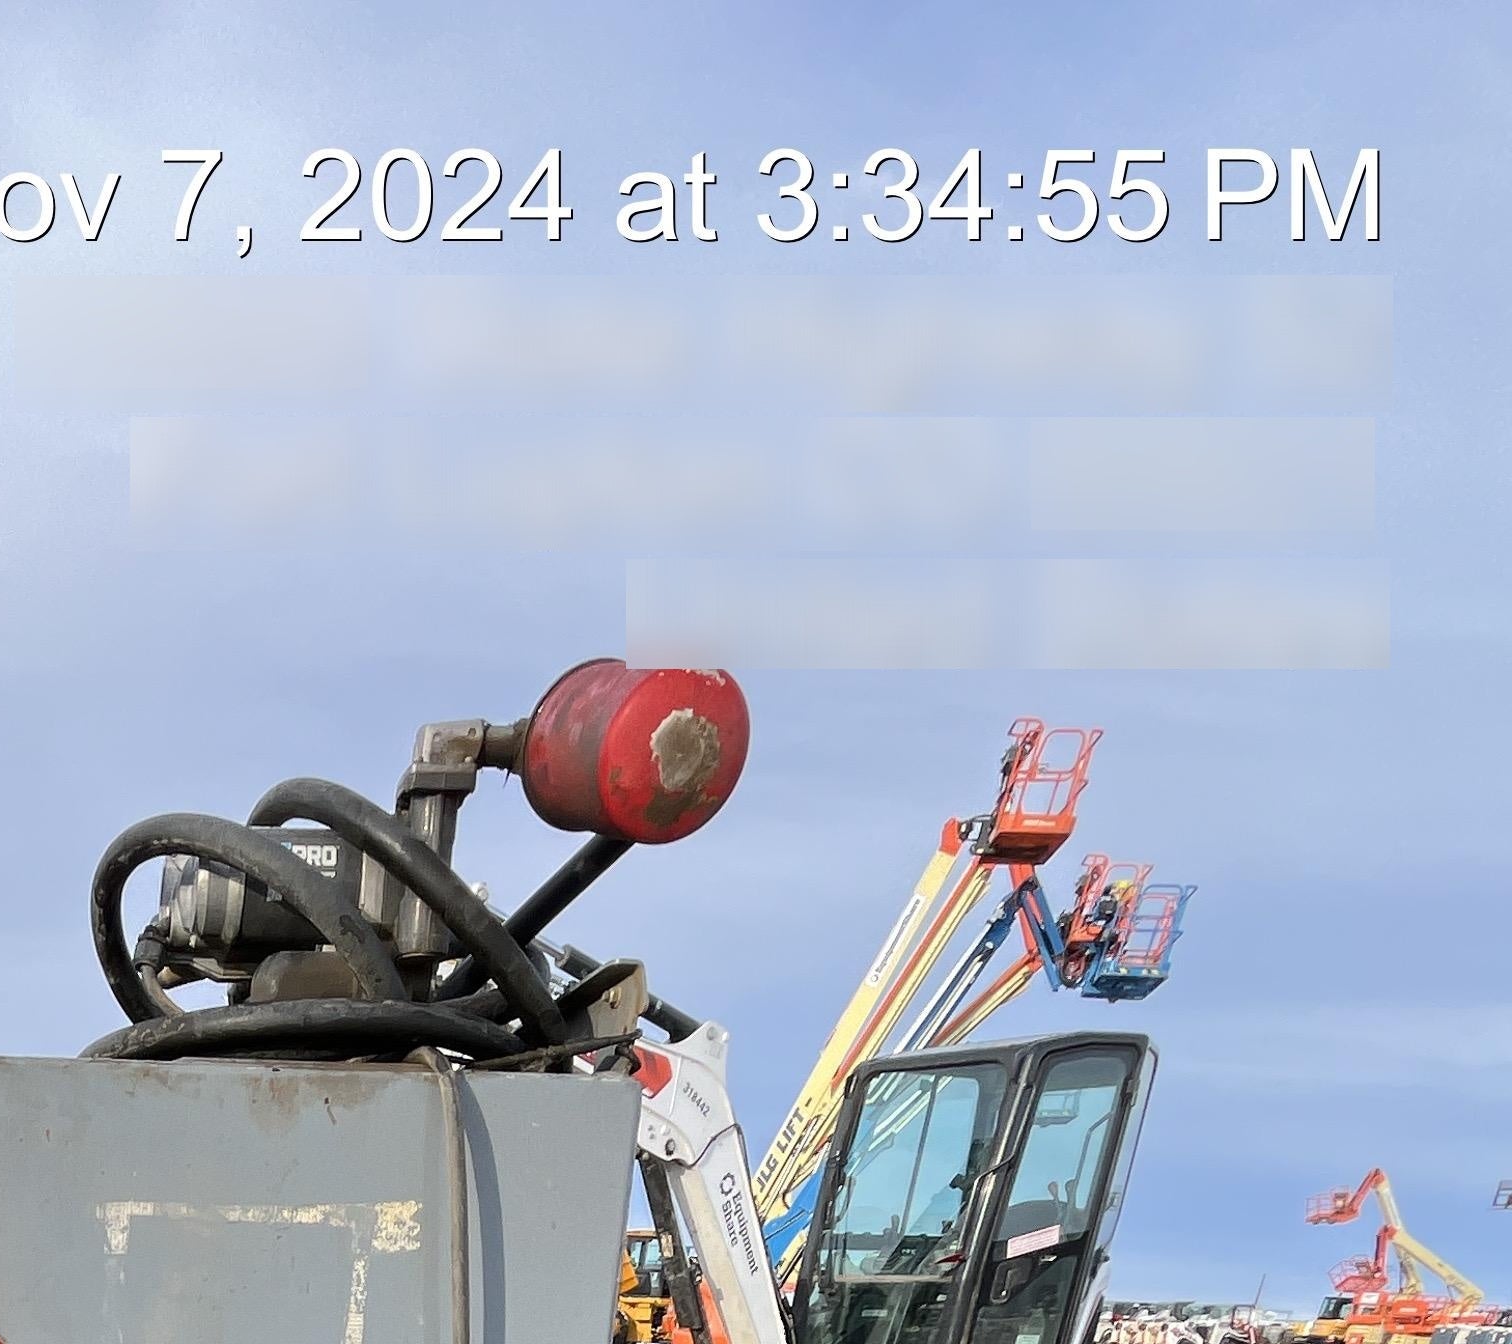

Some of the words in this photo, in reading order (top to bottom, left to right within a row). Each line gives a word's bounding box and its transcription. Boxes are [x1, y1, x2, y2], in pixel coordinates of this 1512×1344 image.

[682, 1081, 711, 1118] 318442
[757, 1153, 779, 1193] JLG
[776, 1107, 805, 1151] LIFT
[722, 1201, 739, 1248] Share
[732, 1186, 759, 1276] Equipment
